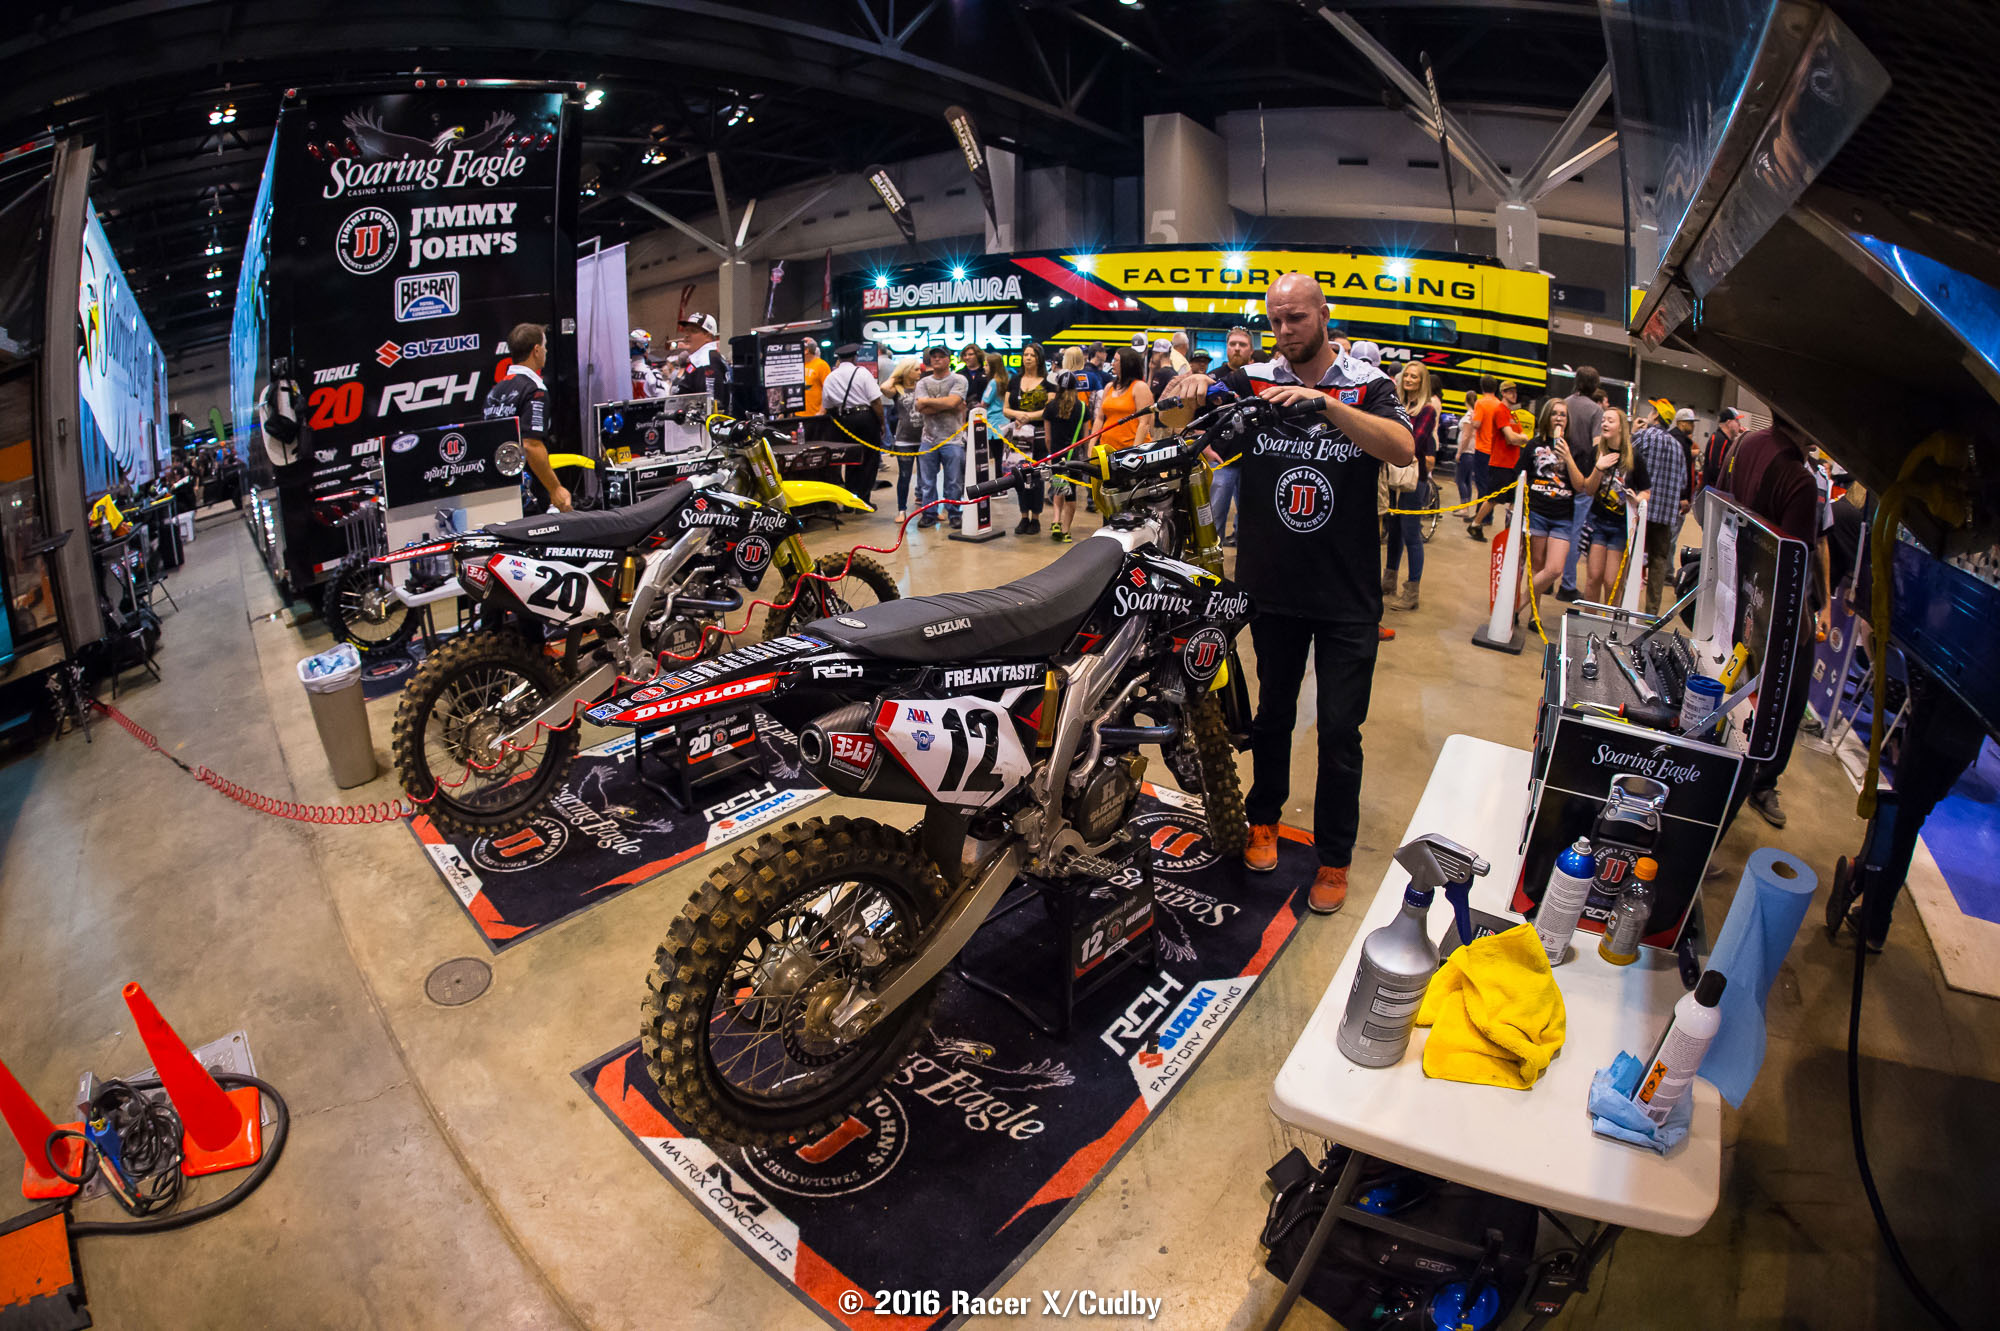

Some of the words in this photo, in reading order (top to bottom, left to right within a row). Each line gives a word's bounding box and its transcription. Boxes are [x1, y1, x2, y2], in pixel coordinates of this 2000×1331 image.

[323, 153, 443, 199] Soaring
[442, 150, 527, 188] Eagle
[347, 187, 377, 197] CASINO
[387, 184, 416, 193] RESORT
[872, 173, 901, 213] SUZUKI
[410, 203, 517, 237] JIMMY
[353, 225, 382, 258] JJ
[409, 231, 517, 268] JOHN'S
[889, 276, 1023, 308] YOSHIMURA
[1314, 271, 1476, 300] RACING
[402, 334, 480, 360] SUZUKI
[863, 314, 1023, 353] SUZUKI
[313, 363, 360, 385] TICKLE
[308, 381, 364, 431] 20
[377, 371, 481, 417] RCH
[1253, 432, 1315, 460] Soaring
[1314, 438, 1363, 463] Eagle
[1279, 471, 1303, 497] JIMMY
[1305, 471, 1330, 501] JOHN'S
[1289, 484, 1317, 516] JJ
[527, 525, 560, 537] SUZUKI
[678, 508, 740, 530] Soaring
[749, 511, 787, 532] Eagle
[1281, 506, 1326, 528] SANDWICHES
[385, 545, 446, 563] DUNLOP
[545, 547, 583, 559] FREAKY
[586, 549, 614, 559] FAST!
[527, 565, 588, 613] 20
[1113, 585, 1192, 617] Soaring
[1204, 590, 1248, 619] Eagle
[1785, 550, 1801, 627] MATRIX
[923, 617, 972, 639] SUZUKI
[813, 665, 863, 680] RCH
[945, 667, 1000, 688] FREAKY
[1002, 664, 1036, 683] FAST!
[634, 678, 770, 721] DUNLOP
[1764, 638, 1789, 752] CONCEPTS
[729, 723, 750, 736] TICKLE
[907, 708, 933, 723] AMA
[689, 733, 711, 757] 20
[835, 736, 874, 763] ヨシムラ
[937, 708, 1000, 793] 12
[1592, 744, 1657, 776] Soaring
[1653, 758, 1701, 784] Eagle
[703, 782, 777, 822] RCH
[714, 812, 768, 842] FACTORY
[769, 793, 814, 816] RACING
[735, 792, 796, 822] SUZUKI
[579, 819, 643, 855] Eagle
[432, 844, 449, 866] MATRIX
[446, 863, 474, 900] CONCEPTS
[1153, 876, 1177, 891] RESO
[1154, 887, 1240, 926] Soar
[1081, 930, 1104, 963] 12
[1100, 970, 1184, 1056] RCH
[1158, 987, 1217, 1051] SUZUKI
[1150, 1034, 1205, 1093] FACTORY
[1201, 985, 1242, 1030] RACING
[914, 1069, 1045, 1140] Eagle
[659, 1140, 713, 1189] MATRIX
[709, 1188, 793, 1262] CONCEPTS
